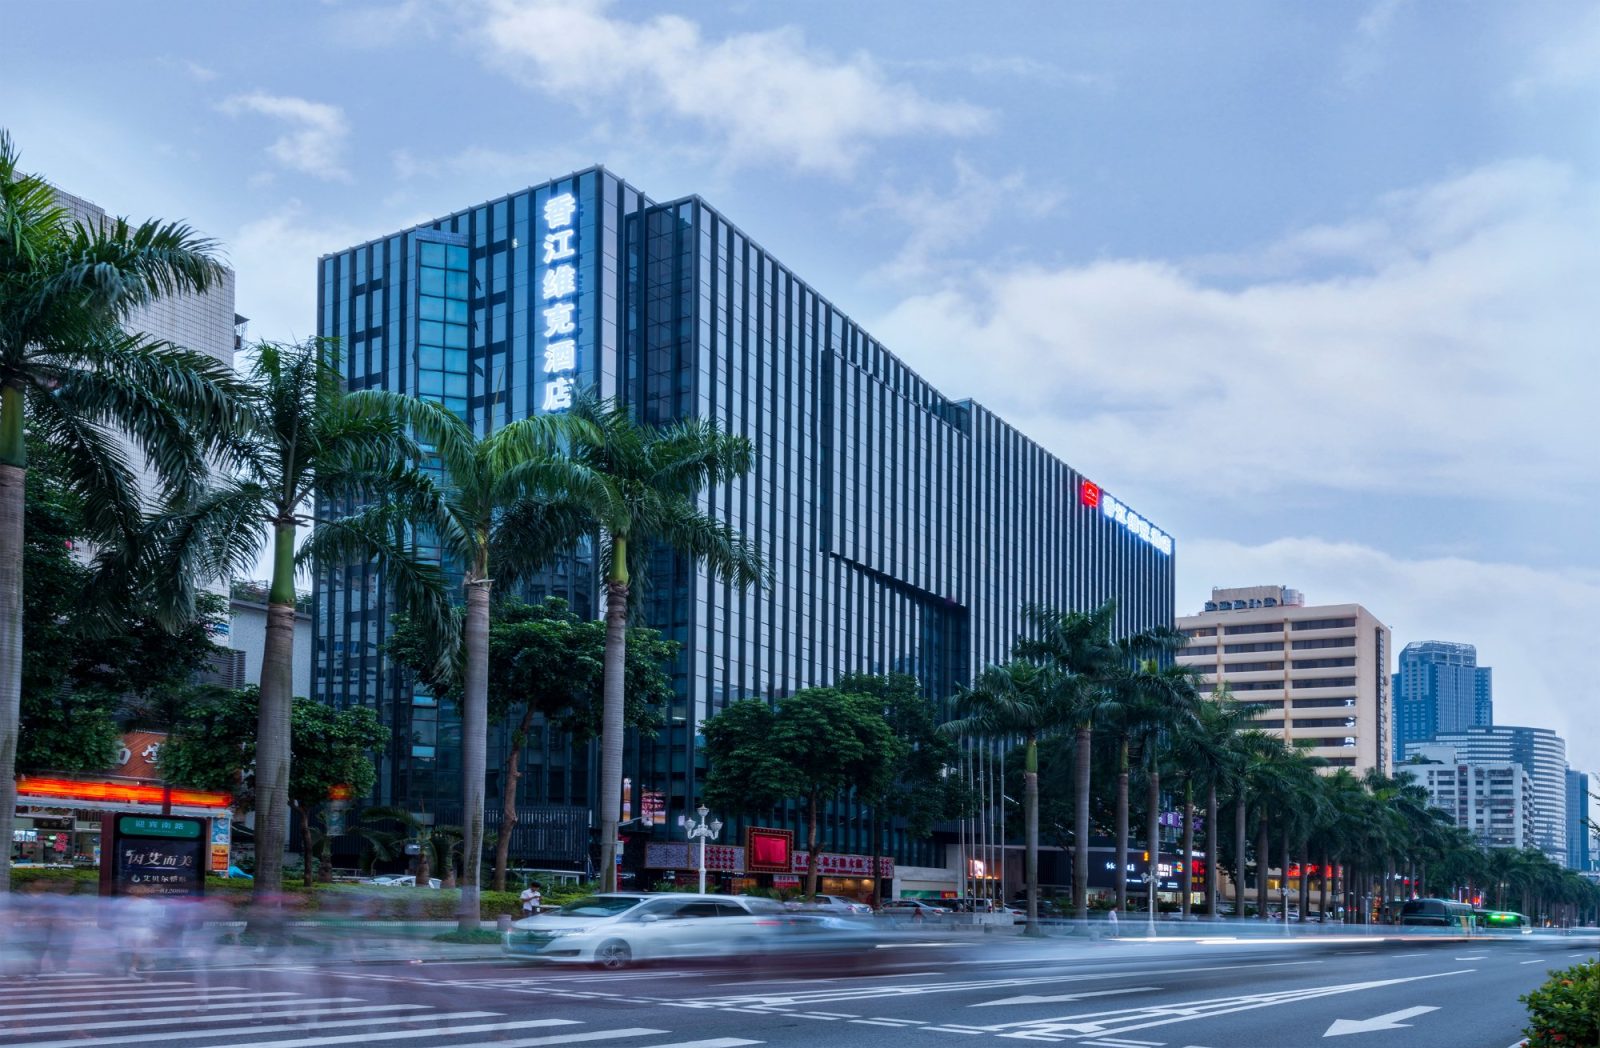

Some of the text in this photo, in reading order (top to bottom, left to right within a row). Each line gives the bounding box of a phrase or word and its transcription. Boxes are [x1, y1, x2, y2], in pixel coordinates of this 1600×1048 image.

[543, 193, 575, 410] 香江维克酒店
